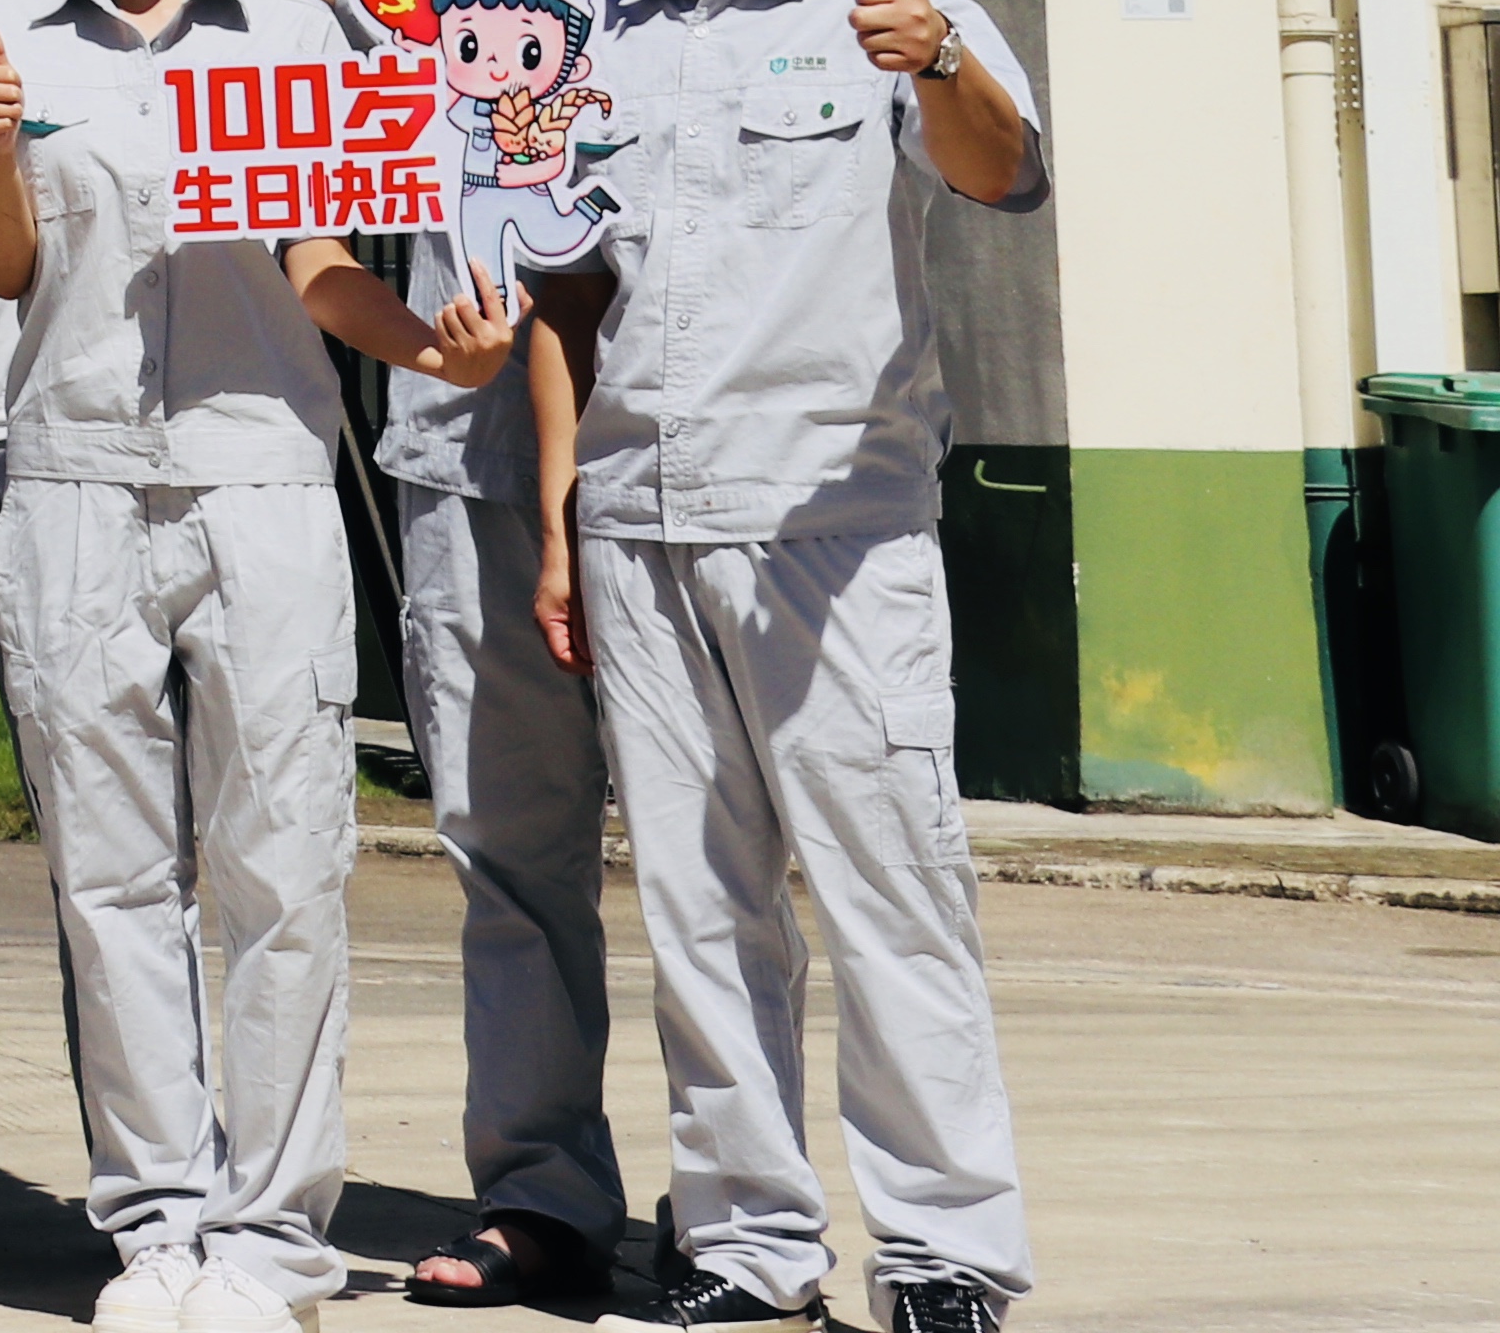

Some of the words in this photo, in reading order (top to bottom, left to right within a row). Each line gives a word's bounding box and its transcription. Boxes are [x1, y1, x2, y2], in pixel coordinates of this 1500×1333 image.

[164, 54, 438, 153] 100岁
[173, 155, 444, 233] 生日快乐
